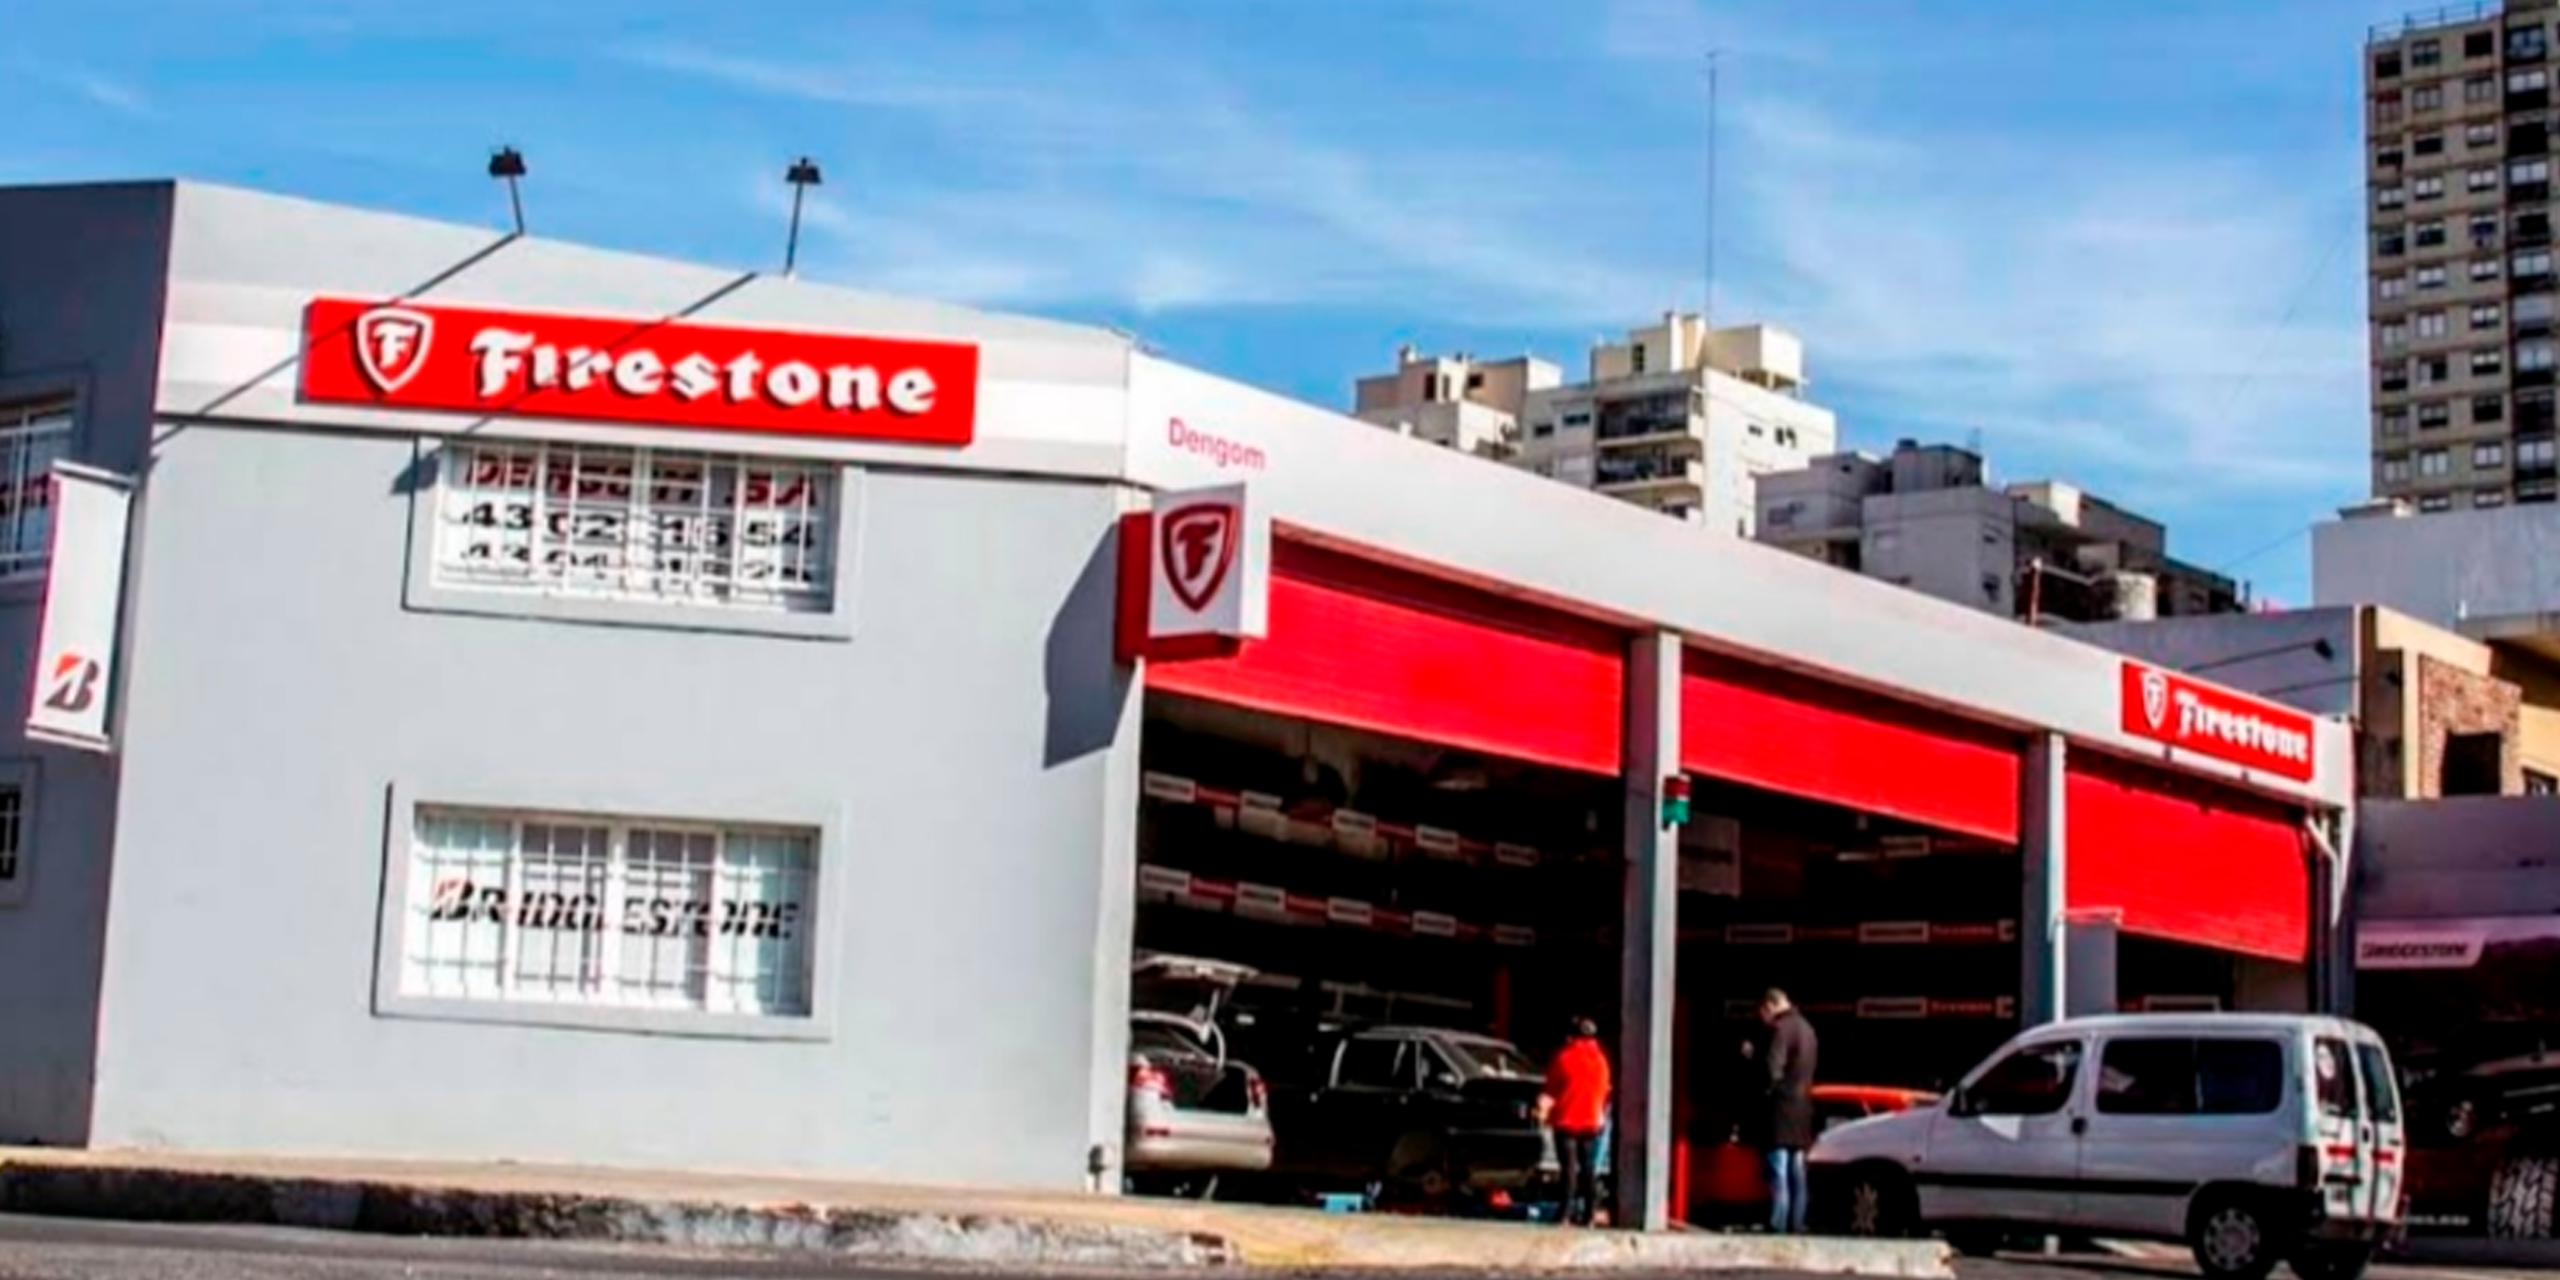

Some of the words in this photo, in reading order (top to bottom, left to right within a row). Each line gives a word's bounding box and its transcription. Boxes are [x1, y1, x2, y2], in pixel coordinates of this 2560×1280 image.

[469, 328, 937, 414] Firestone
[1168, 416, 1266, 470] Dengom
[2174, 689, 2308, 764] Firestone
[430, 879, 800, 941] BRIDGESTONE
